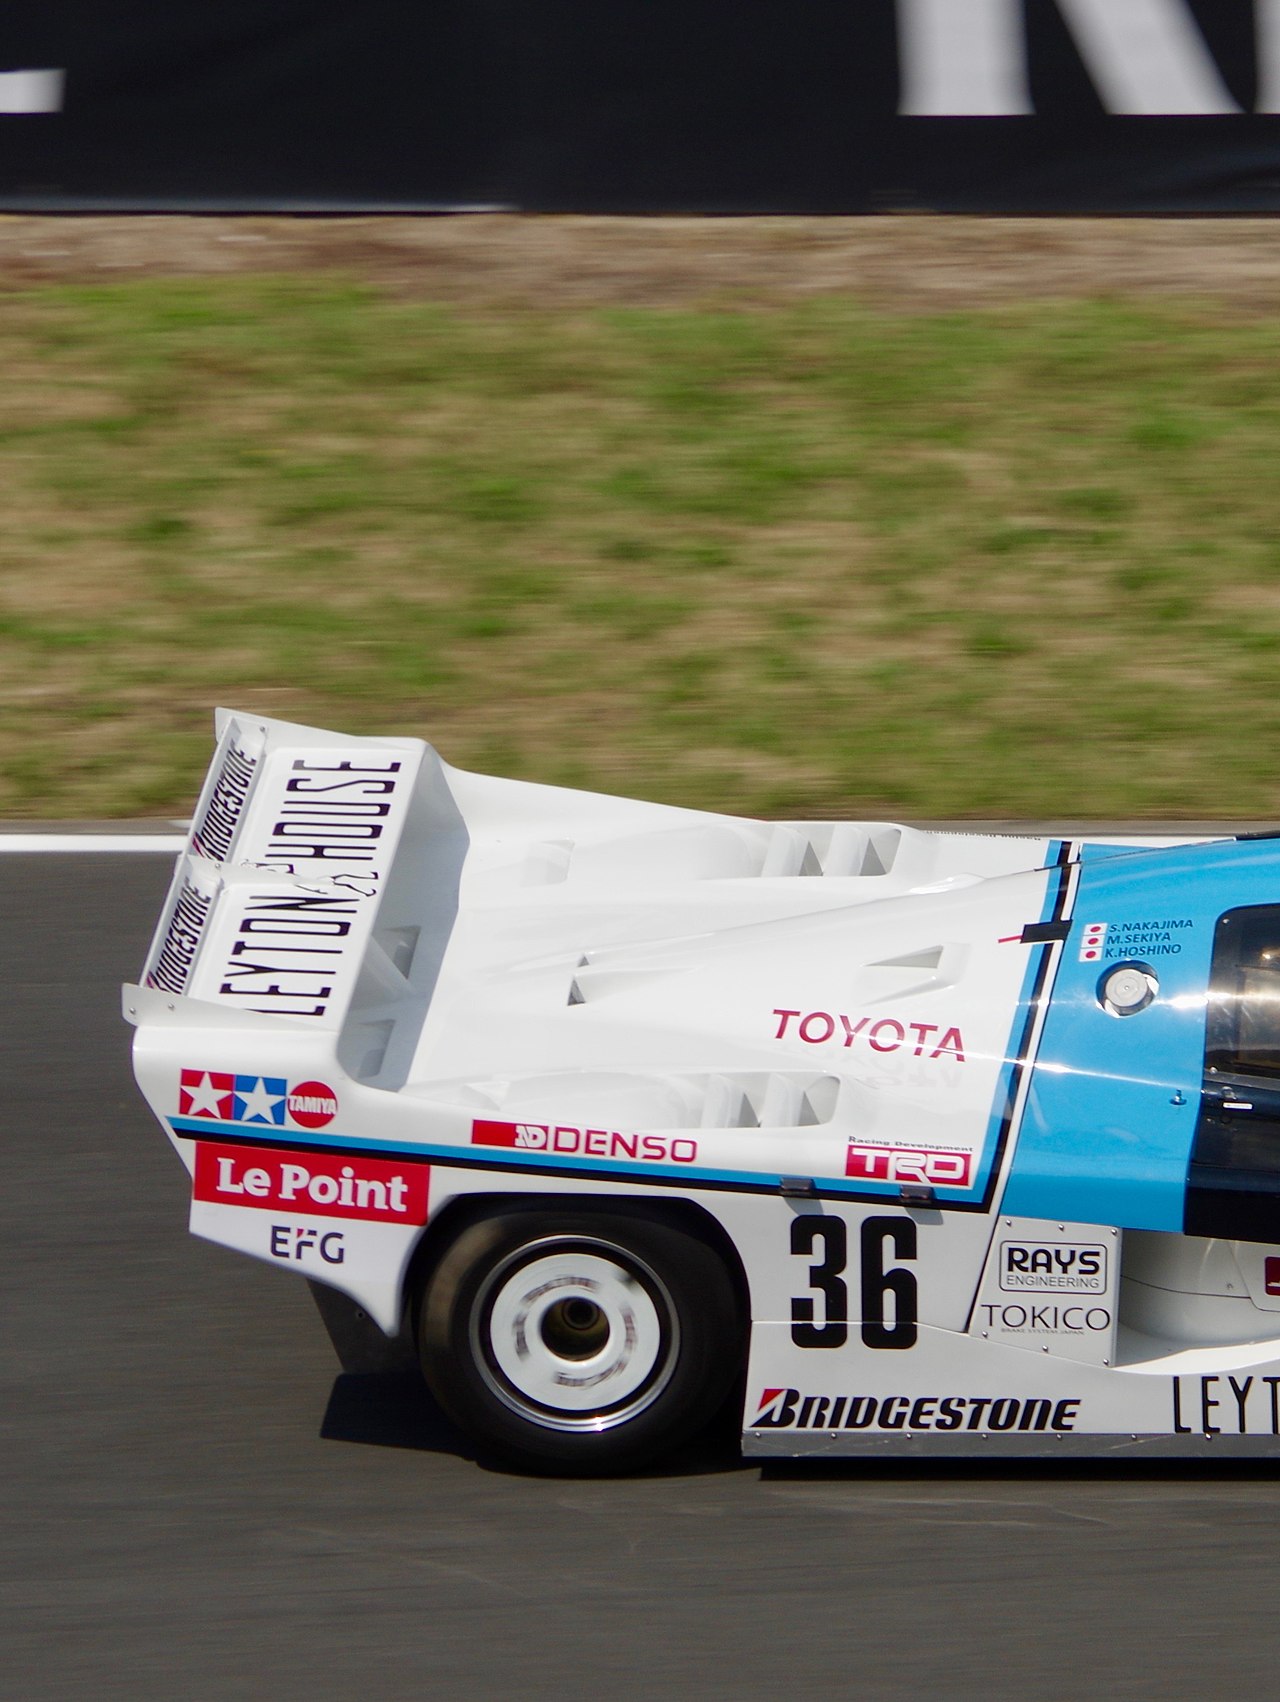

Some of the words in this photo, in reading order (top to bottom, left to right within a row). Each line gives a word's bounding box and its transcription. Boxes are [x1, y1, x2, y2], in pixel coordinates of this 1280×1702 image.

[264, 759, 402, 860] HOUSE
[1106, 932, 1171, 945] M.SEKIYA
[1108, 919, 1194, 933] S.NAKAJIMA
[218, 895, 361, 1017] LEYTON
[1104, 944, 1182, 959] K.HOSHINO
[772, 1009, 966, 1063] TOYOTA
[288, 1095, 337, 1115] TAMIYA
[553, 1127, 697, 1162] DENSO
[851, 1147, 965, 1184] TRD
[215, 1157, 271, 1197] Le
[278, 1166, 408, 1212] Point
[270, 1225, 345, 1264] EFG
[1007, 1247, 1100, 1275] RAYS
[790, 1214, 918, 1349] 36
[1006, 1274, 1100, 1288] ENGINEERING
[980, 1304, 1111, 1331] TOKICO
[750, 1388, 1081, 1431] BRIDGESTONE
